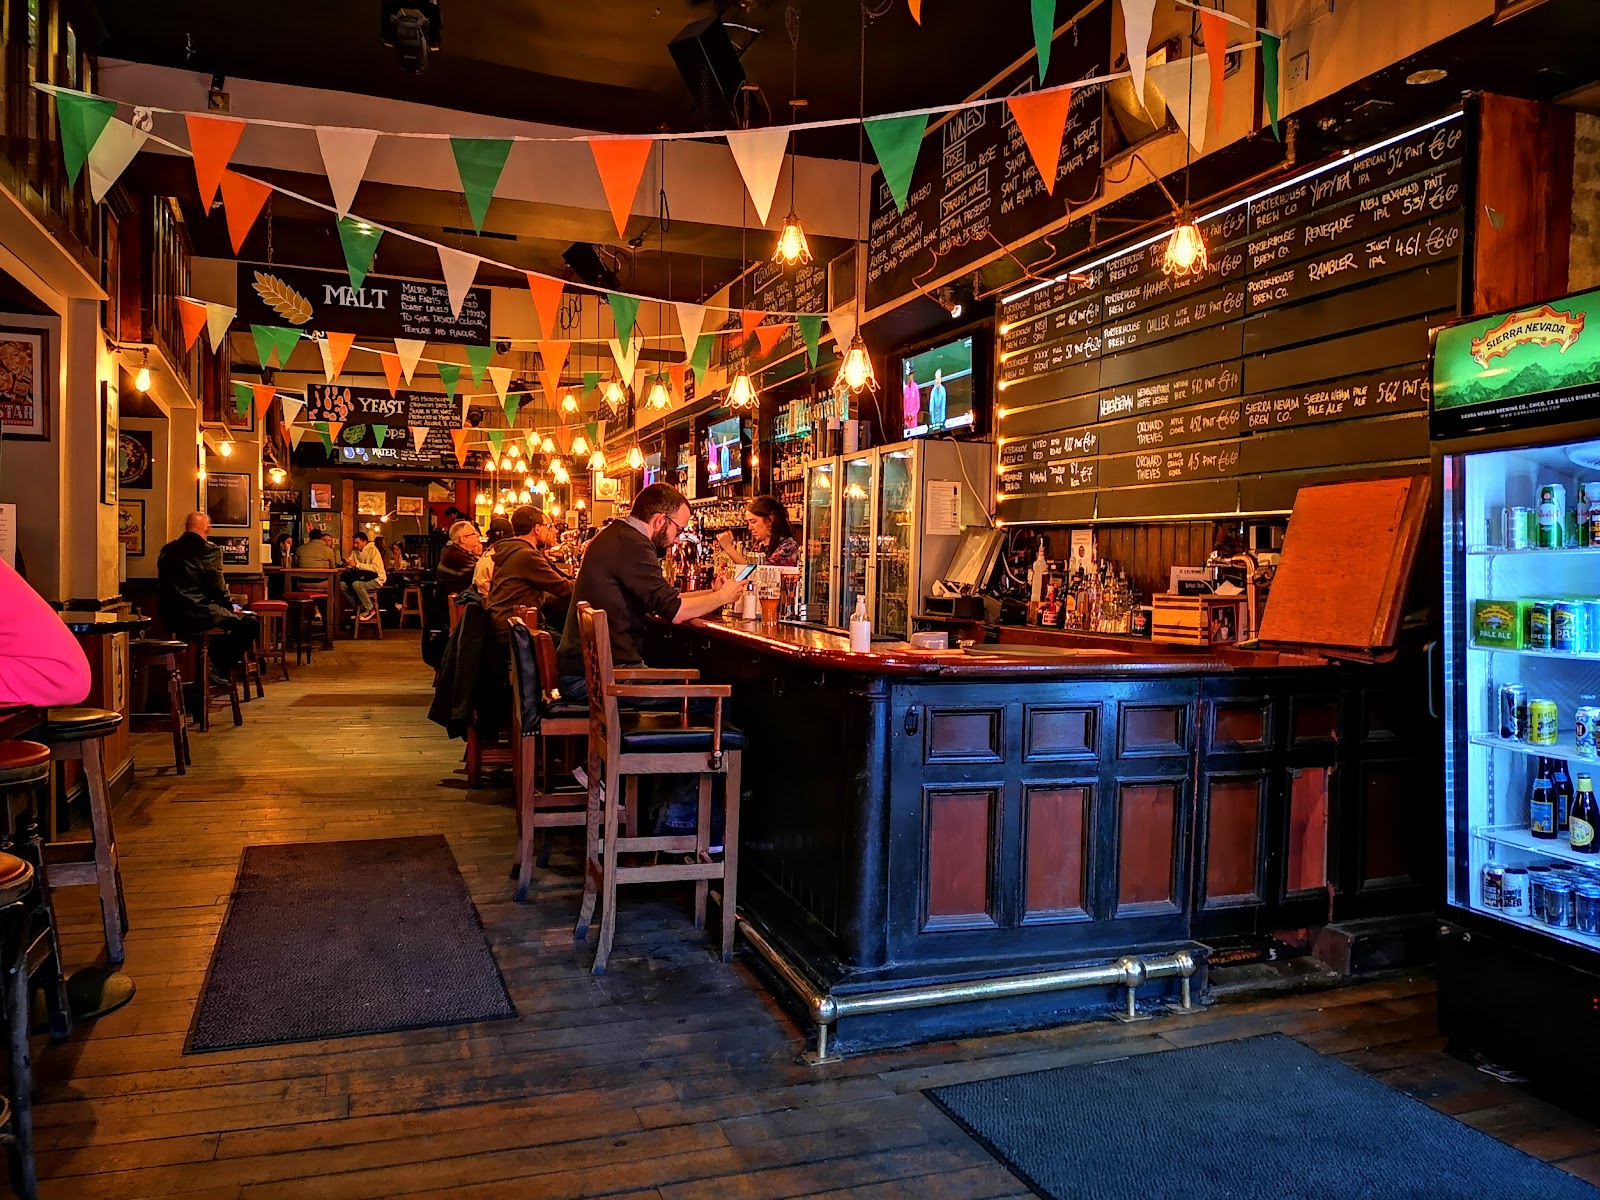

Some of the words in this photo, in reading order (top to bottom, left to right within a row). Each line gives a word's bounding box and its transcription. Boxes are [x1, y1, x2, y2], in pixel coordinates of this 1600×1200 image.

[949, 105, 983, 143] WINES
[1073, 116, 1101, 150] MERLOT
[978, 144, 998, 167] ROSE
[1404, 142, 1426, 161] PINT
[946, 149, 963, 170] ROSE
[1353, 151, 1387, 173] AMERICAN
[1358, 175, 1370, 185] IPA
[1424, 173, 1447, 192] PINT
[1251, 185, 1307, 216] PORTERHOUSE
[1360, 196, 1380, 212] NEW
[1256, 212, 1279, 229] BREW
[1373, 207, 1390, 221] IPA
[1305, 214, 1355, 246] RENEGADE
[1248, 228, 1296, 256] PORTERHOUSE
[1105, 250, 1145, 272] PORTERHOUSE
[1253, 252, 1277, 269] BREW
[1308, 253, 1358, 282] RAMBLER
[1369, 255, 1387, 269] IPA
[1109, 269, 1127, 283] BREW
[1247, 270, 1295, 293] PORTERHOUSE
[402, 282, 427, 294] MALTED
[1034, 288, 1049, 302] PLAIN
[1143, 278, 1172, 300] HAMMER
[322, 284, 389, 309] MALT
[418, 294, 441, 305] FARMS
[1105, 287, 1141, 305] PORTERHOUSE
[1252, 292, 1273, 306] BREW
[401, 302, 423, 312] ROAST
[1108, 303, 1124, 316] BREW
[1176, 307, 1188, 317] LITE
[1209, 301, 1222, 314] PINT
[400, 312, 412, 322] TO
[1147, 314, 1170, 334] CHILLER
[1174, 317, 1191, 327] LAGER
[402, 324, 431, 335] TEXTURE
[1104, 321, 1141, 338] PORTERHOUSE
[1486, 326, 1523, 351] SIERRA
[1524, 322, 1566, 334] NEVADA
[1108, 336, 1125, 349] BREW
[1034, 348, 1050, 360] XXXX
[1033, 359, 1050, 372] STOUT
[1204, 378, 1216, 390] PINT
[1352, 385, 1368, 396] PALE
[1402, 378, 1421, 397] PINT
[1245, 399, 1271, 415] SIERRA
[1273, 397, 1299, 412] NEVADA
[1303, 393, 1329, 407] SIERRA
[1354, 397, 1367, 407] ALE
[1496, 406, 1518, 414] BREWING
[1559, 395, 1575, 403] MILLS
[357, 397, 406, 418] YEAST
[1307, 405, 1324, 417] PALE
[1325, 404, 1344, 416] ALE
[1137, 419, 1164, 434] ORCHARD
[1202, 416, 1216, 428] PINT
[1248, 413, 1270, 427] BREW
[384, 428, 406, 440] OPS
[1137, 431, 1163, 445] THIEVES
[372, 448, 399, 459] WATER
[1202, 455, 1217, 466] PINT
[1136, 455, 1162, 468] ORCHARD
[1137, 468, 1161, 481] THIEVES
[1480, 630, 1497, 638] PALE
[1497, 632, 1511, 640] ALE
